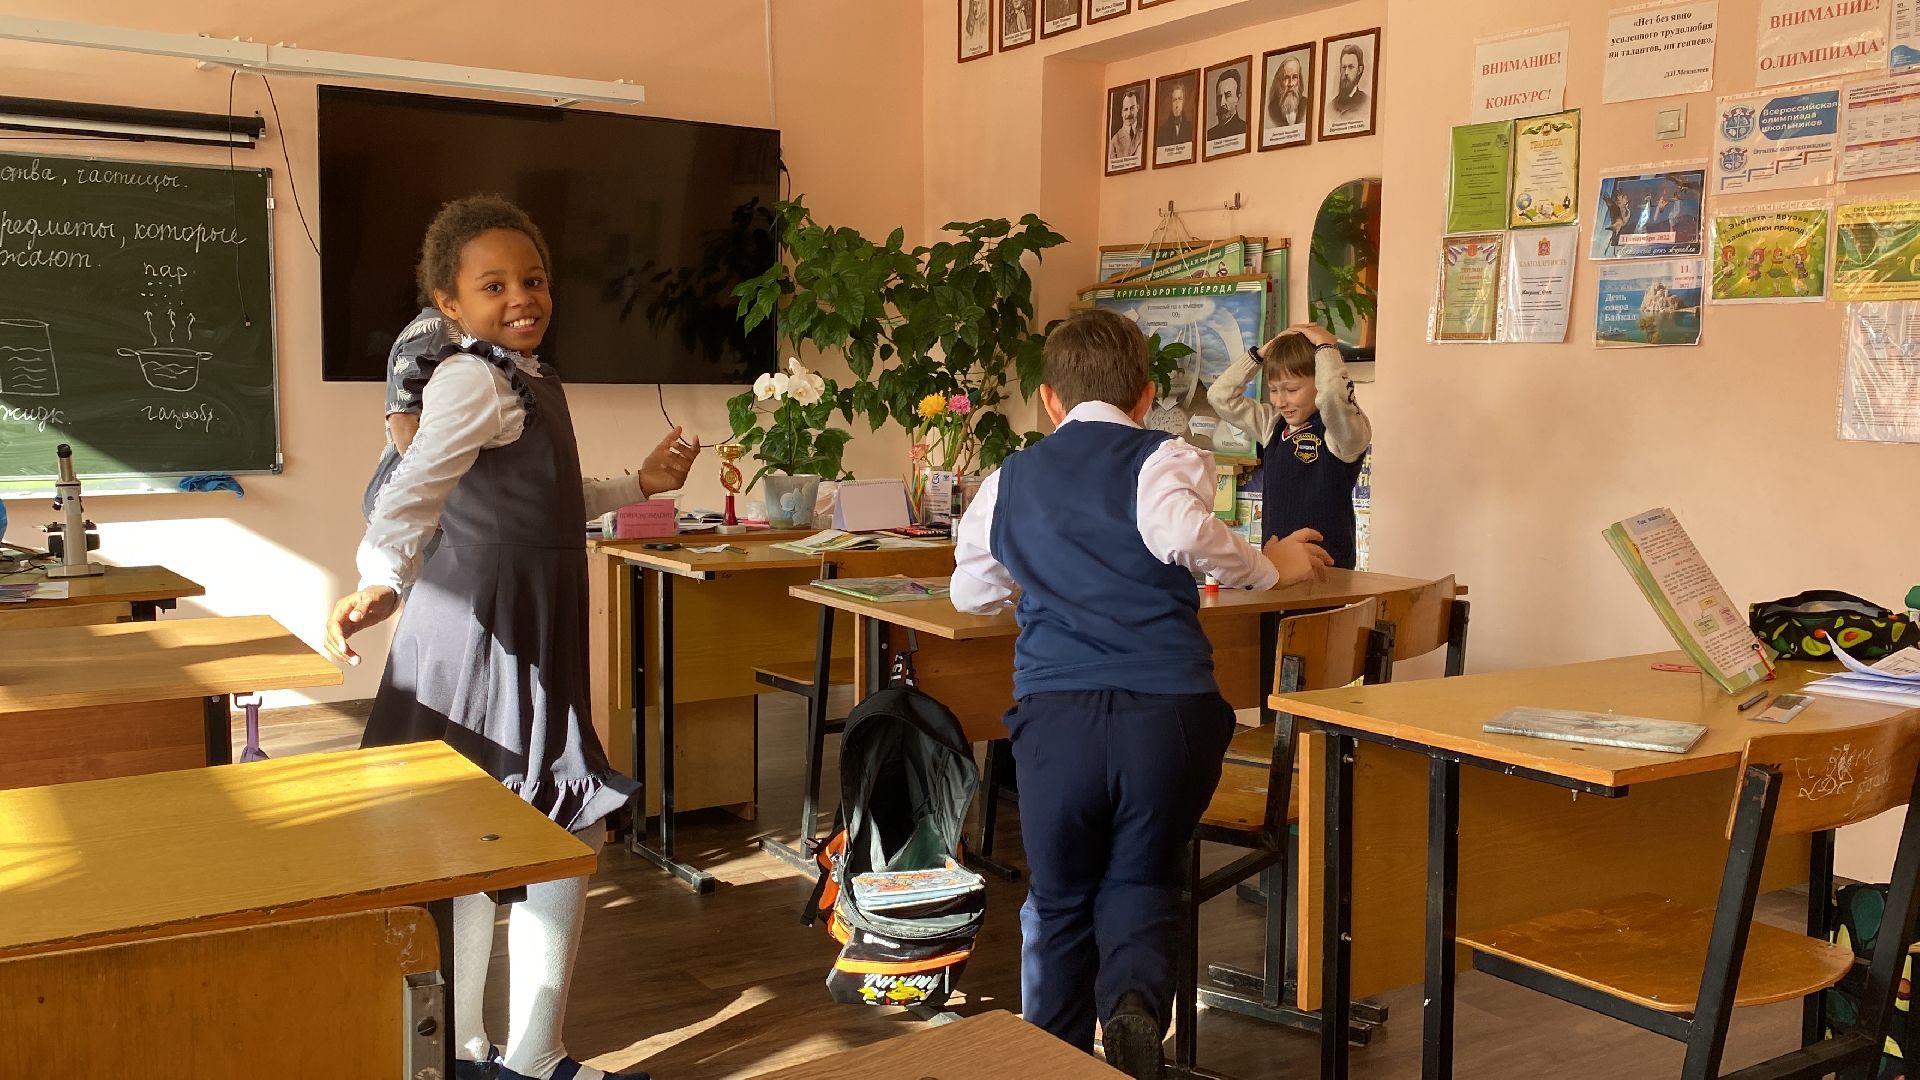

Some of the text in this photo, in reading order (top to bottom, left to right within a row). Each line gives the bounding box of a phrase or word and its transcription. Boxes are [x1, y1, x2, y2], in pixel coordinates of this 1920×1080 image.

[1656, 14, 1670, 23] без
[1671, 12, 1693, 21] явно
[1769, 0, 1881, 29] ВНИМАНИЕ!
[1660, 22, 1714, 38] трудолюбия
[1664, 43, 1676, 51] ни
[1481, 51, 1562, 76] ВНИМАНИЕ!
[1485, 88, 1552, 110] КОНКУРС!
[1763, 101, 1838, 117] Всероссийская
[1761, 112, 1817, 124] олимпиада
[1761, 120, 1823, 133] школьников
[134, 222, 248, 254] которые
[143, 261, 188, 285] пар
[1681, 265, 1689, 274] 11
[1116, 284, 1232, 298] КРУГОВОРОТ УГЛЕРОДА
[1604, 293, 1627, 302] День
[1604, 304, 1630, 314] озера
[1604, 313, 1637, 321] Байкал
